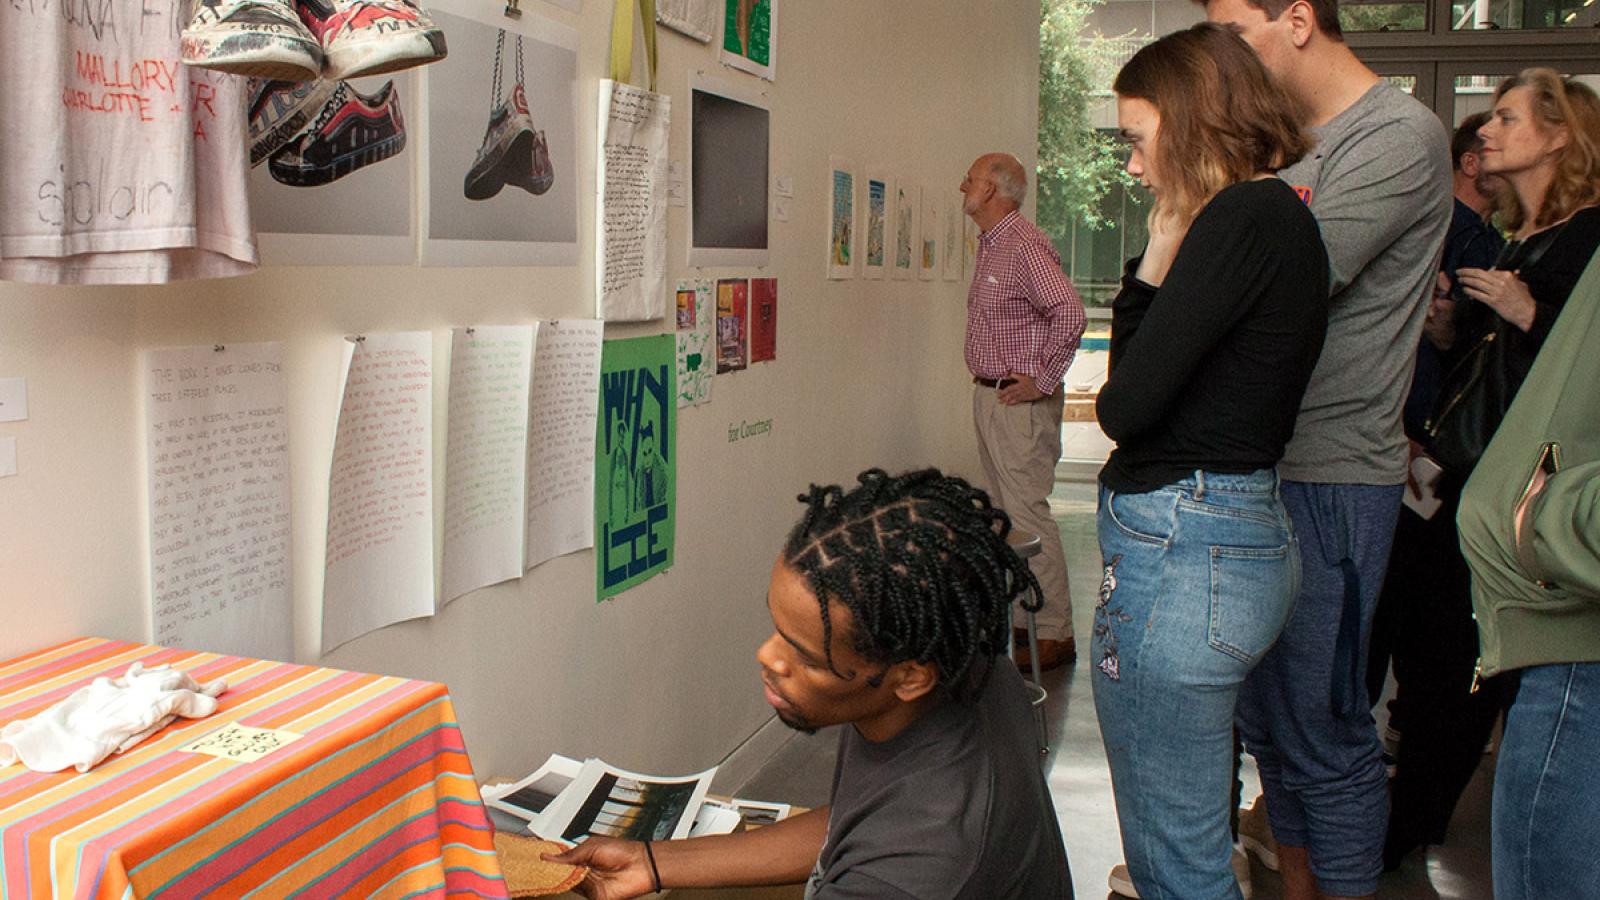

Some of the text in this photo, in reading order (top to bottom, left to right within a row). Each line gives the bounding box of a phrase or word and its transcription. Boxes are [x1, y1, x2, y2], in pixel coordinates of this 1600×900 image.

[76, 50, 180, 93] MALLORY
[602, 364, 669, 480] WHY
[727, 418, 773, 443] for Courtney
[603, 503, 669, 589] LIE
